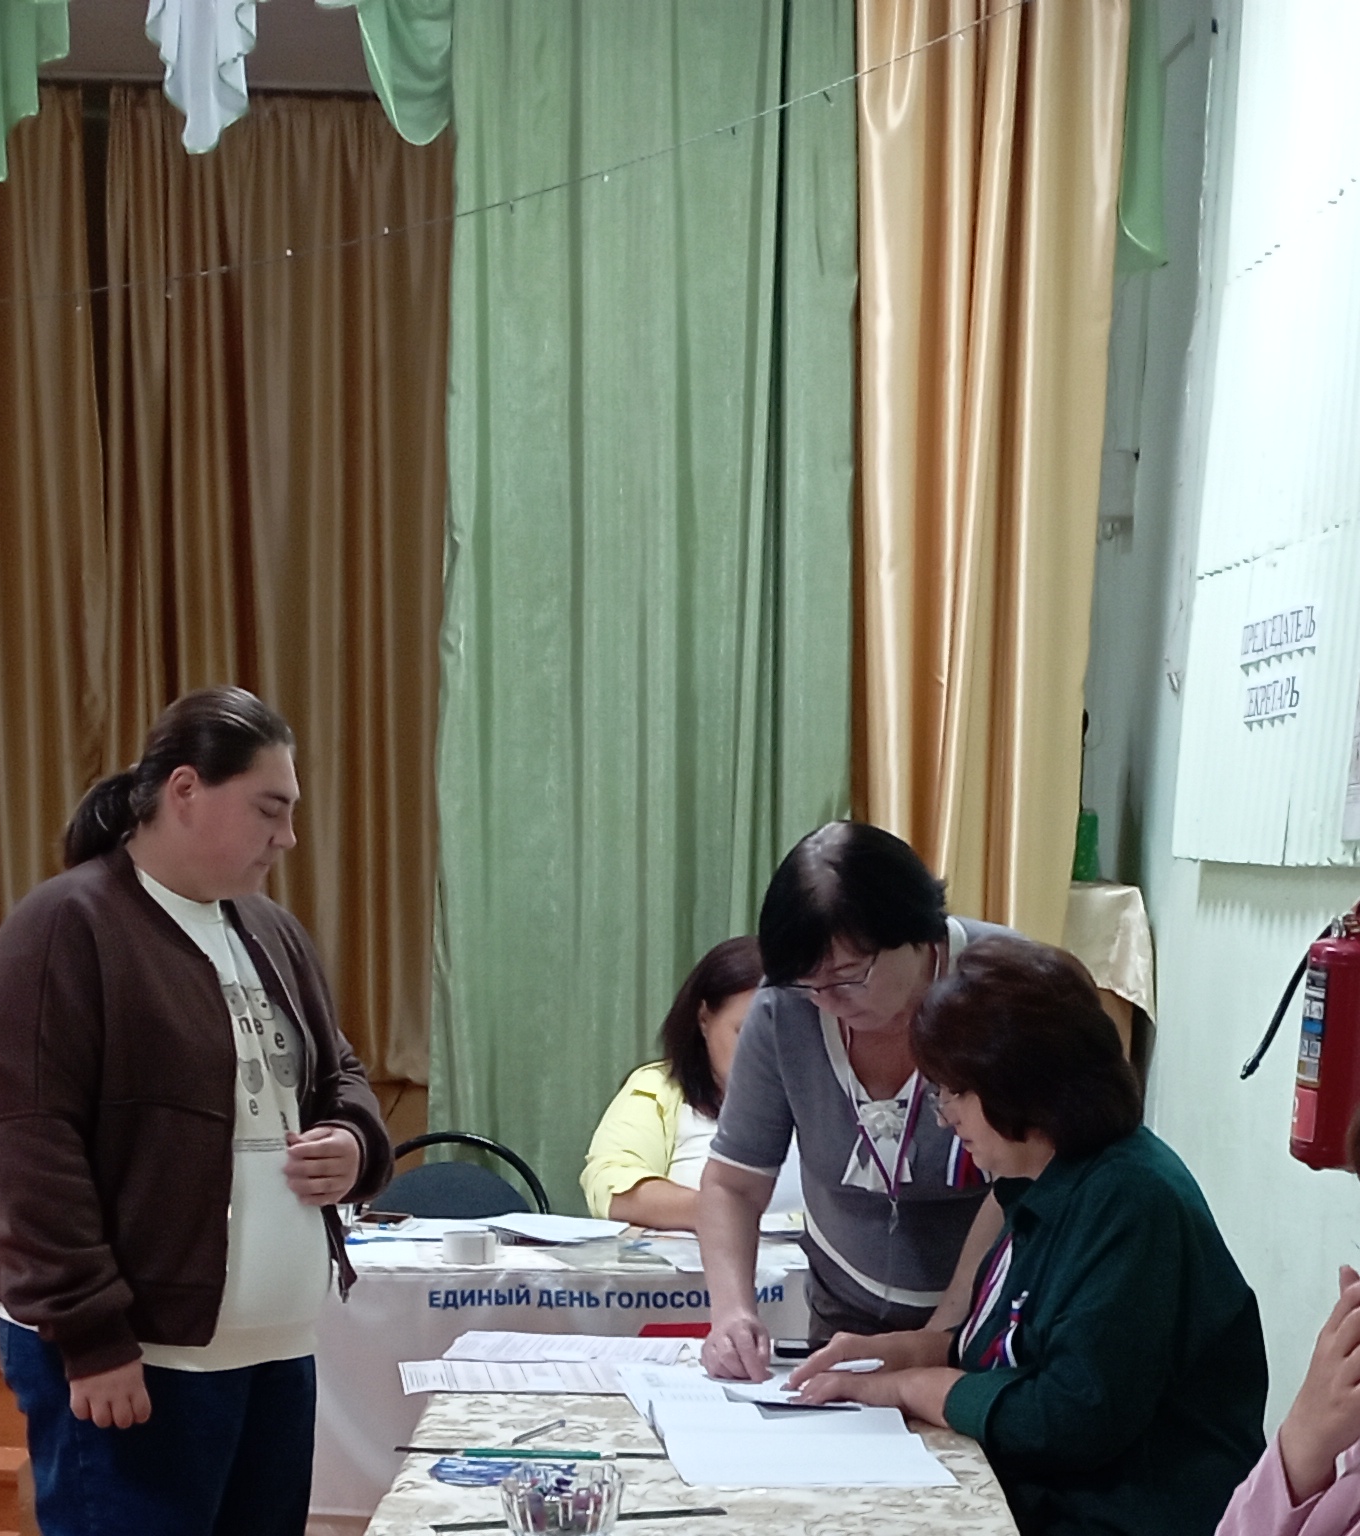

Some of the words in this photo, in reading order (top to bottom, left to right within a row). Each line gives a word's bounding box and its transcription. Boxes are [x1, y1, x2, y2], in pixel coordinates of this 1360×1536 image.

[427, 1284, 532, 1310] ЕДИНЫЙ
[536, 1289, 601, 1310] ДЕНЬ
[605, 1284, 785, 1310] ГОЛОСОИЯ
